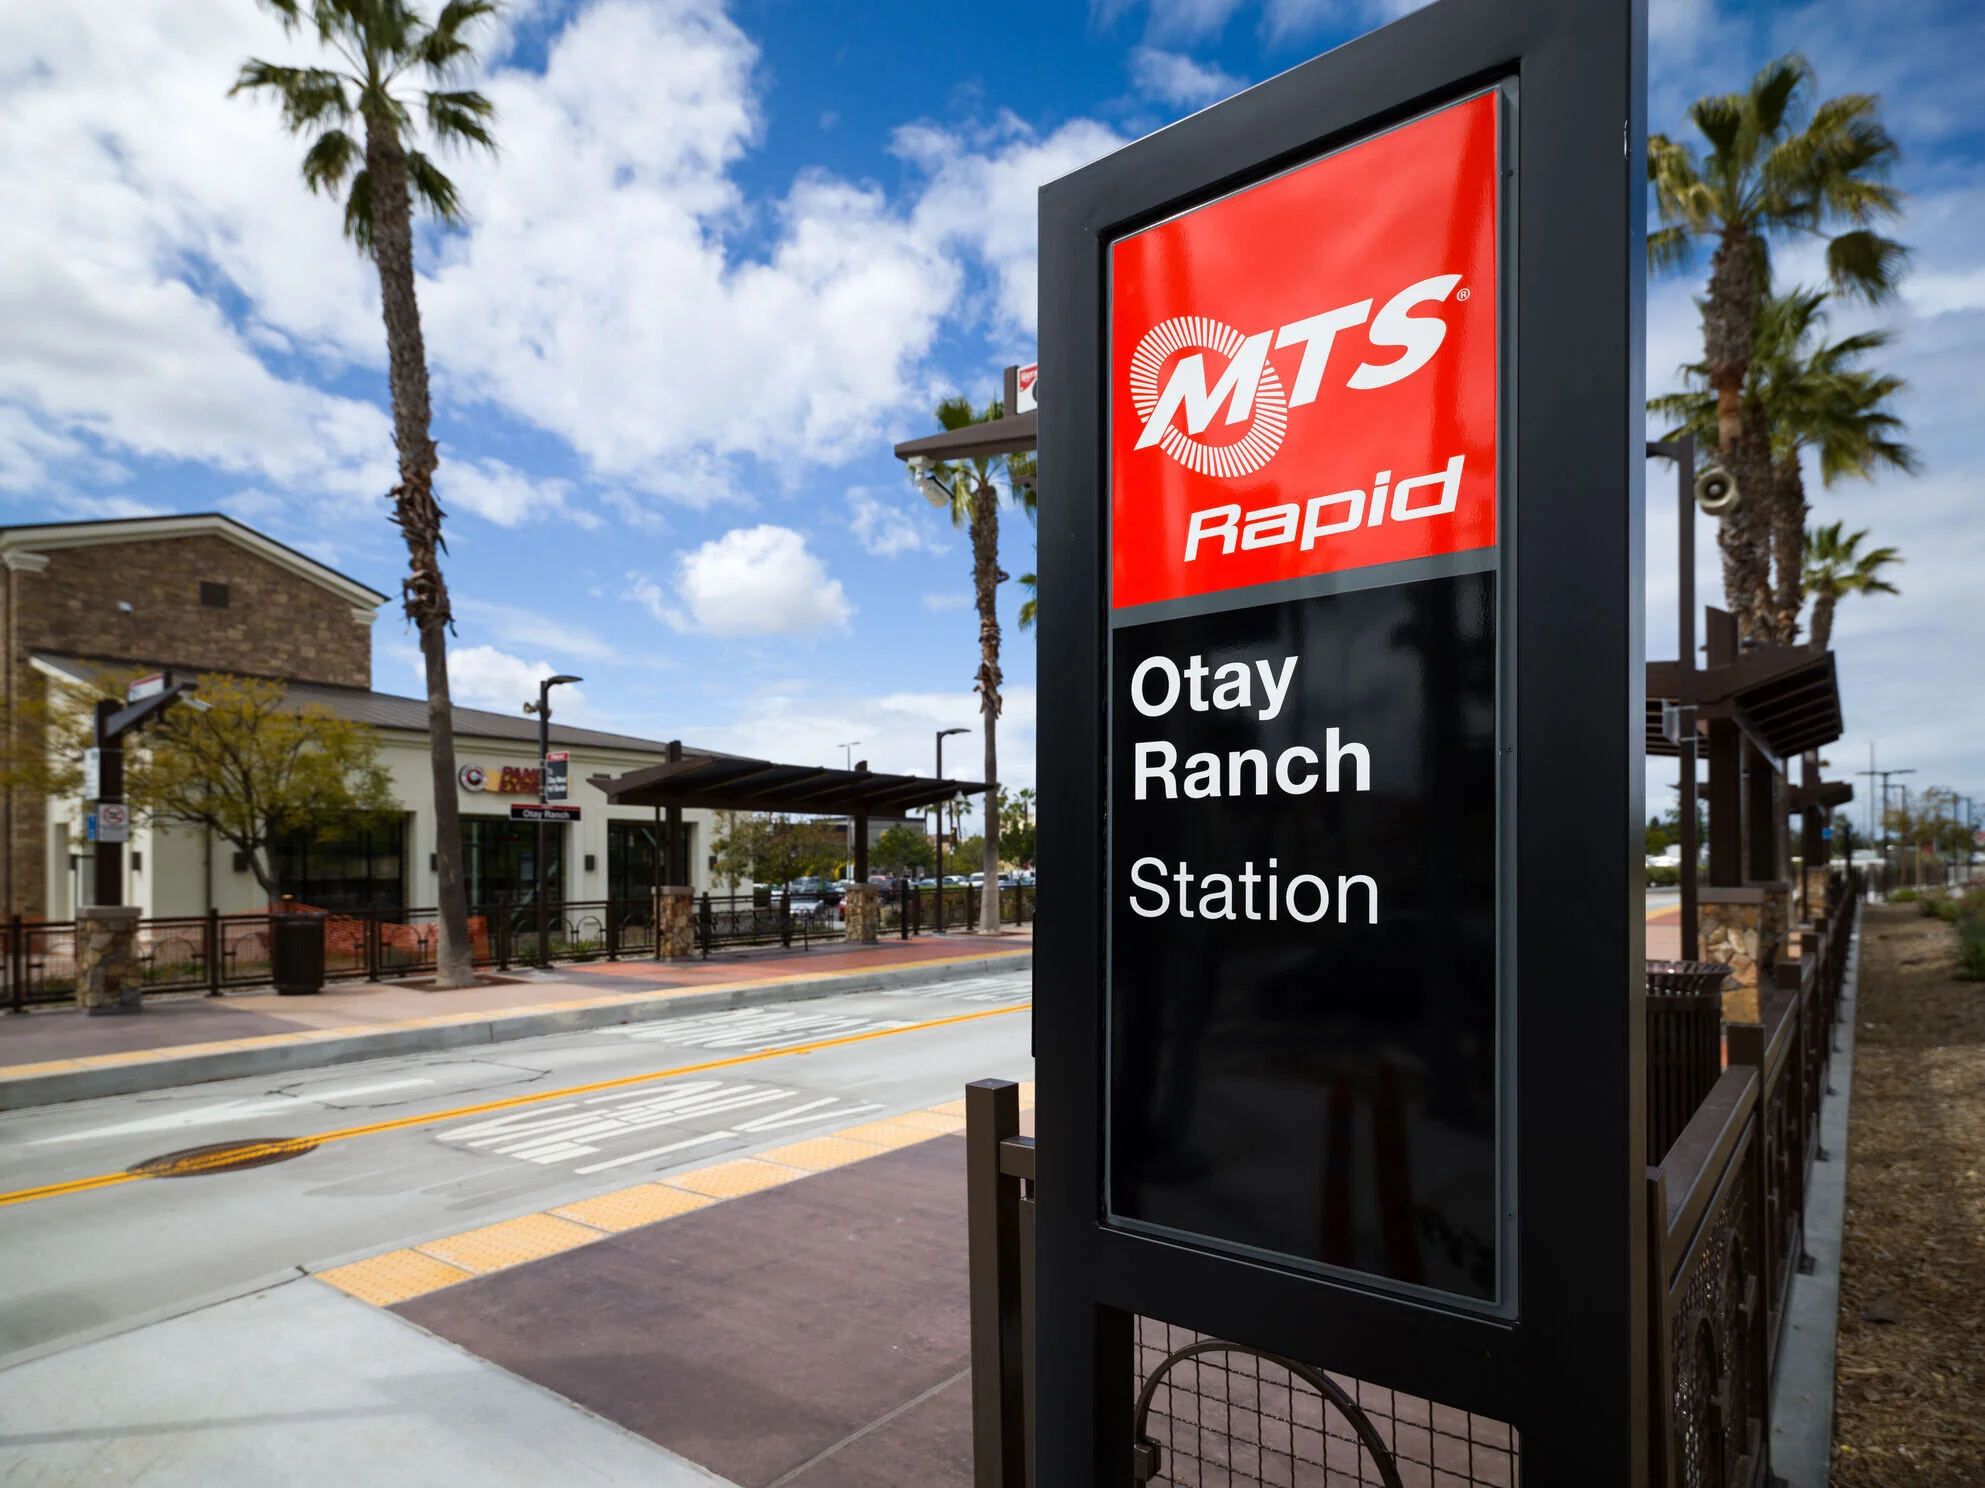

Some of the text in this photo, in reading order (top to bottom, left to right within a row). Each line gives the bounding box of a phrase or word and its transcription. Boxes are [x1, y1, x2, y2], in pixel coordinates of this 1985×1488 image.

[1134, 274, 1463, 451] MTS
[1184, 454, 1465, 561] Rapid
[1130, 655, 1299, 721] Otay
[1134, 727, 1371, 801] Ranch
[522, 809, 570, 819] Otay Ranch
[1129, 856, 1378, 924] Station
[435, 1081, 887, 1175] ONLY
